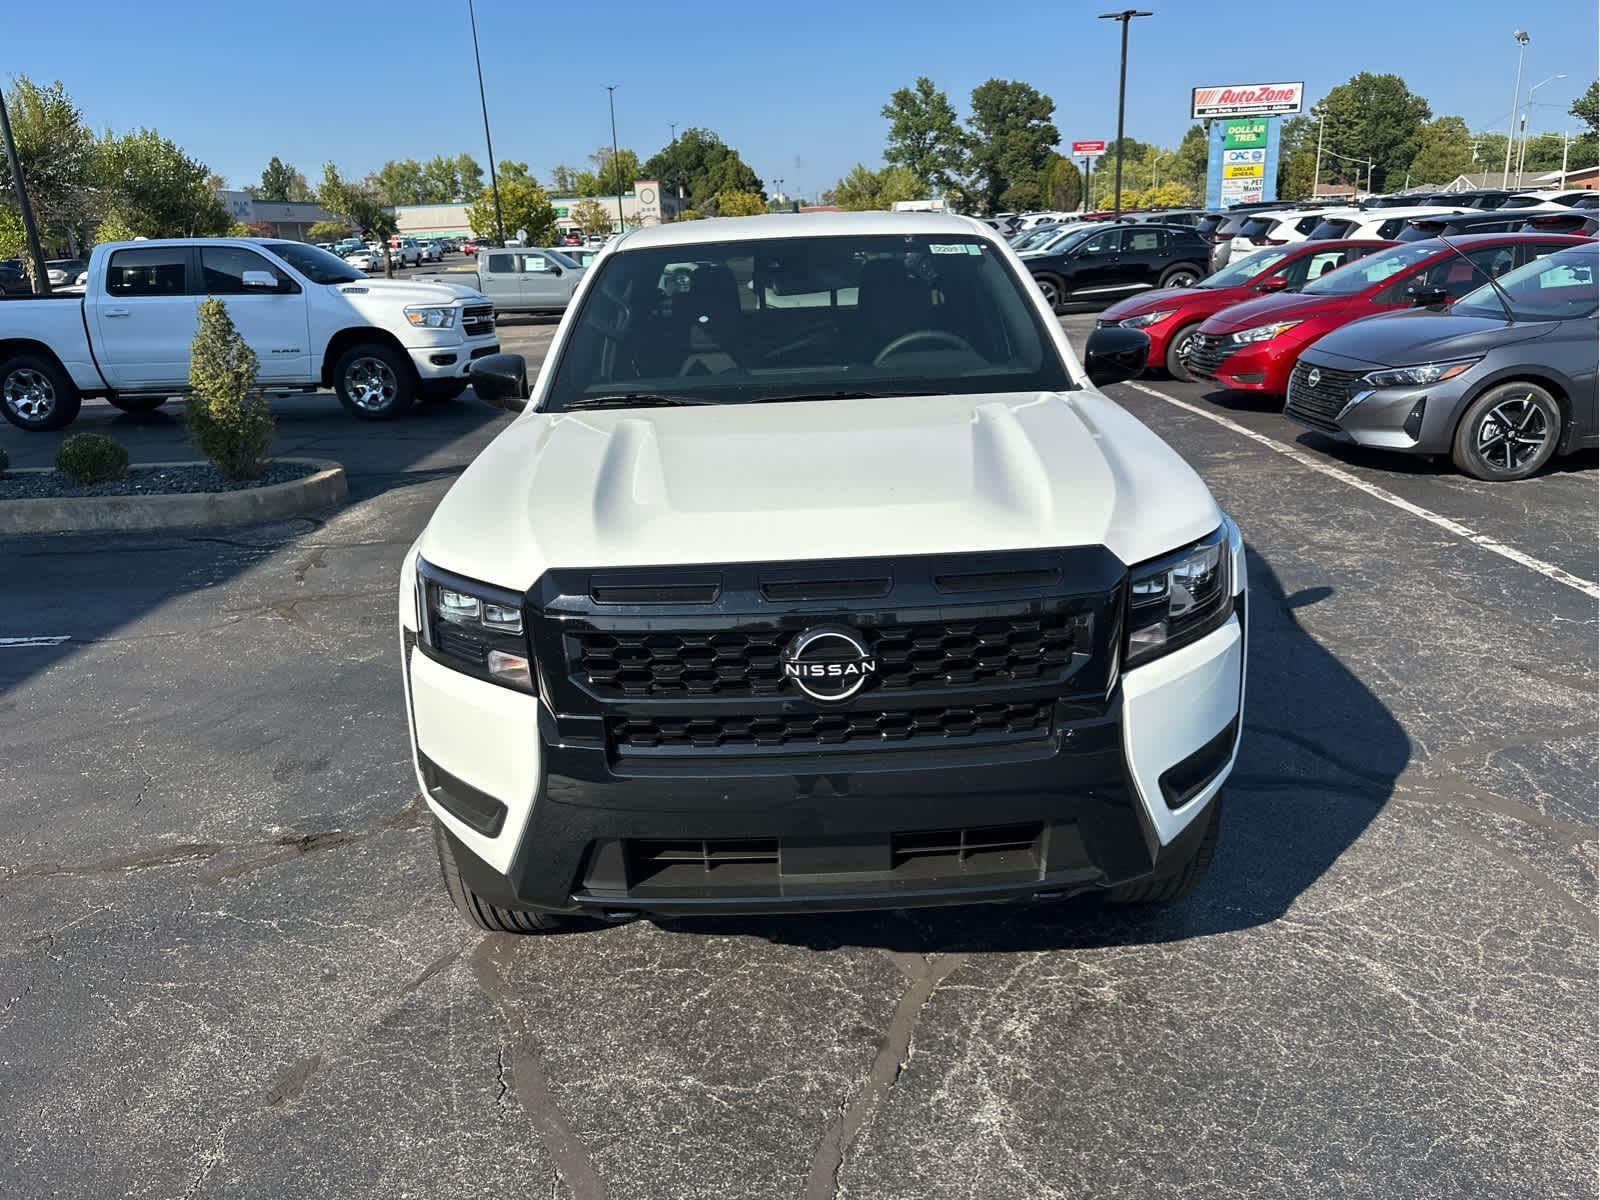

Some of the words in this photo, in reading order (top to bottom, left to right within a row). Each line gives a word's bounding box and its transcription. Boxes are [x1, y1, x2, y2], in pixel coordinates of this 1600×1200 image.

[1218, 87, 1294, 103] AutoZone
[1228, 125, 1265, 134] DOLLAR
[1234, 134, 1257, 142] TREE
[785, 660, 876, 677] NISSAN
